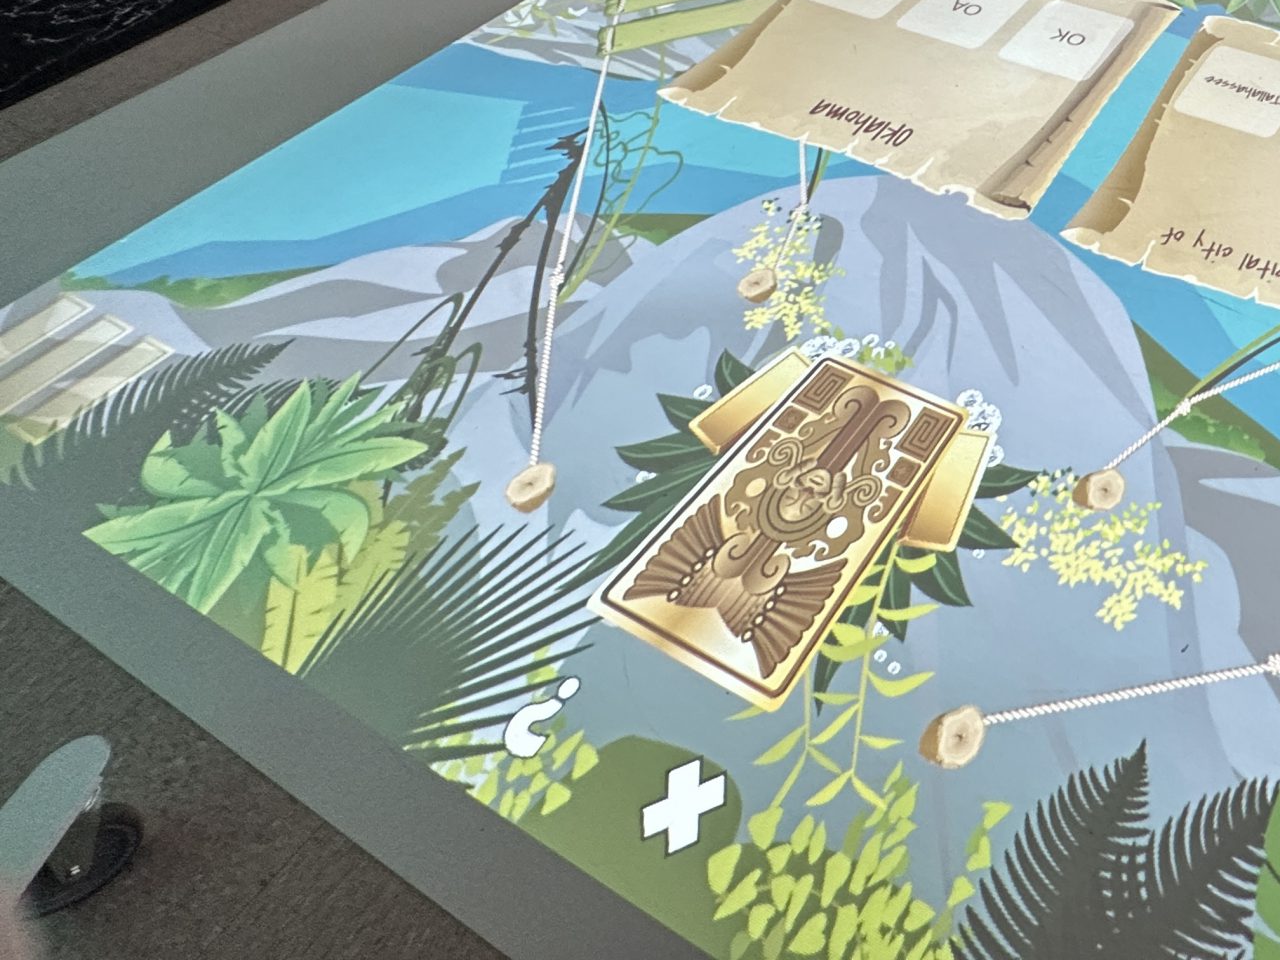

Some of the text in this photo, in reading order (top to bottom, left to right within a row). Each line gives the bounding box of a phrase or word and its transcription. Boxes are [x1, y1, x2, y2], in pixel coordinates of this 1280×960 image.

[1049, 27, 1086, 46] OK
[1160, 226, 1185, 246] of
[1192, 227, 1234, 264] city
